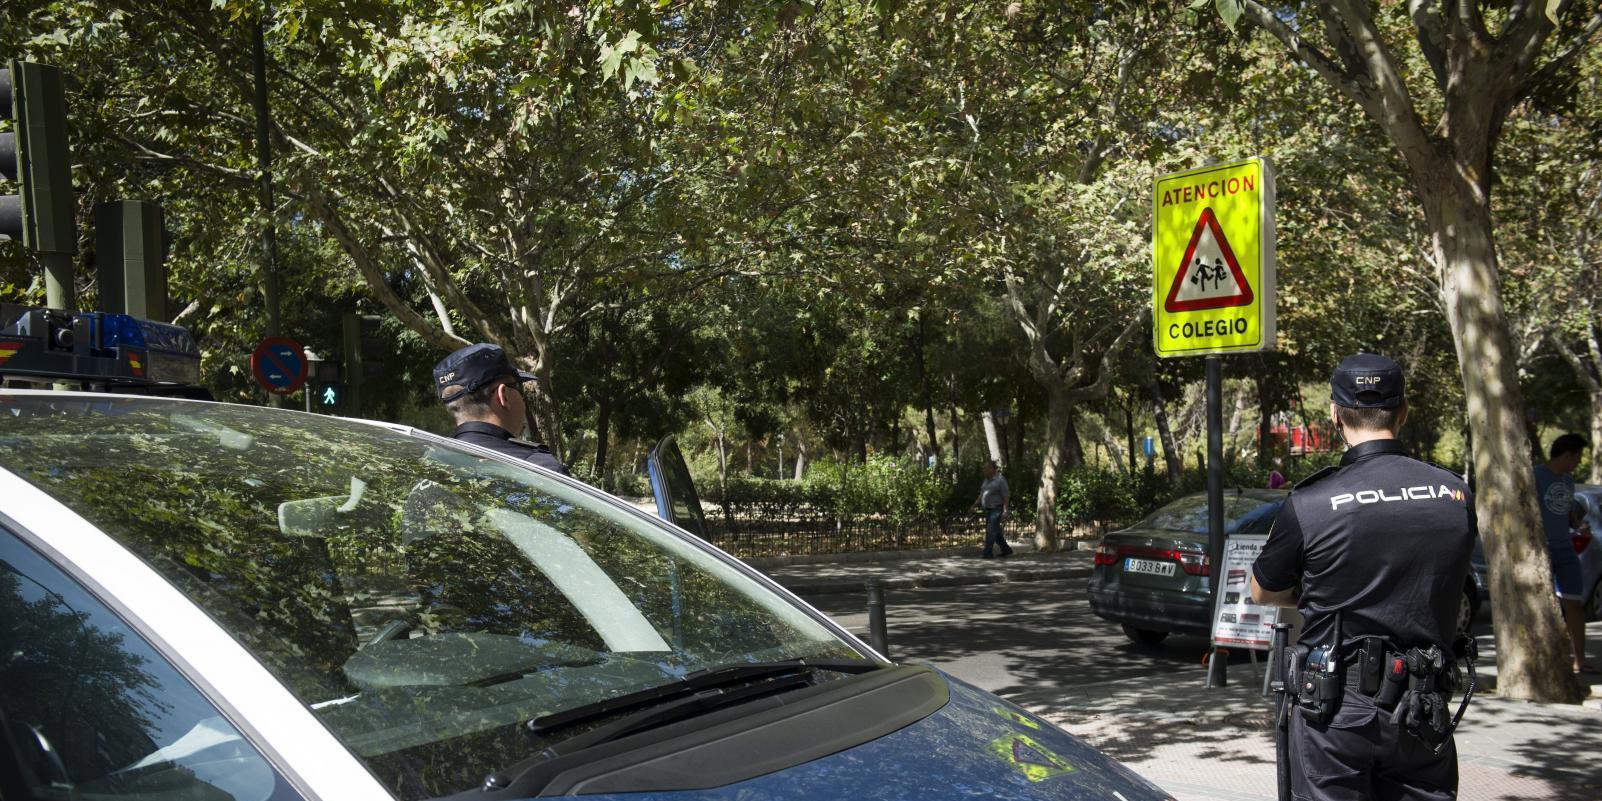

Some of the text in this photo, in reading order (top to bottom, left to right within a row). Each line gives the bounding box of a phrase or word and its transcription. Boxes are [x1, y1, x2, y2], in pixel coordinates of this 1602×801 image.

[1162, 174, 1255, 207] ATENCION
[1169, 317, 1248, 339] COLEGIO
[439, 372, 455, 384] CNP
[1356, 376, 1381, 384] CNP
[1330, 484, 1455, 511] POLICIA
[1130, 559, 1154, 573] 8033
